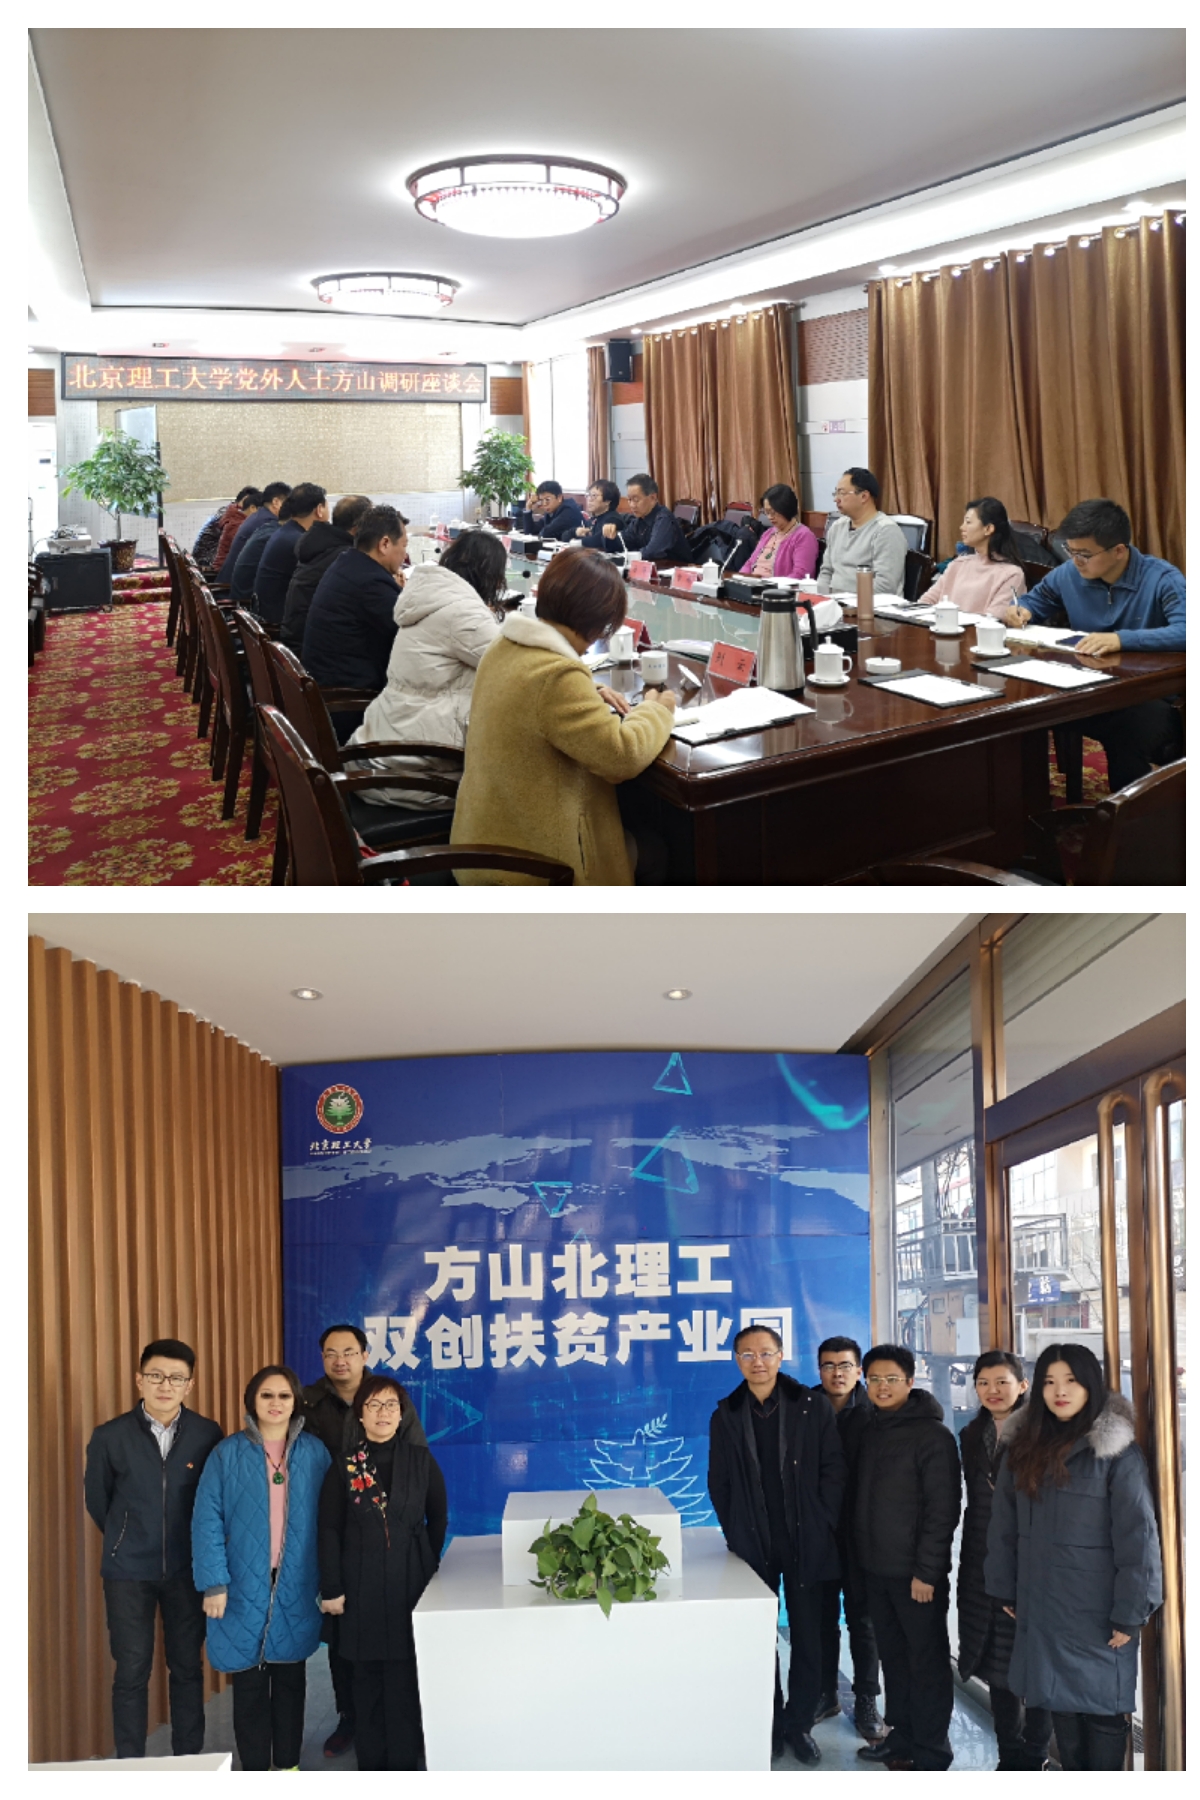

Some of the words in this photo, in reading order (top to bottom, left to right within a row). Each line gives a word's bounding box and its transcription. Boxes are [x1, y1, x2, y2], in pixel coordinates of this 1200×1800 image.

[69, 363, 483, 394] 北京理工大学党外人士方山调研座谈会
[309, 1138, 372, 1151] 北京理工大学
[424, 1243, 733, 1303] 方山北理工
